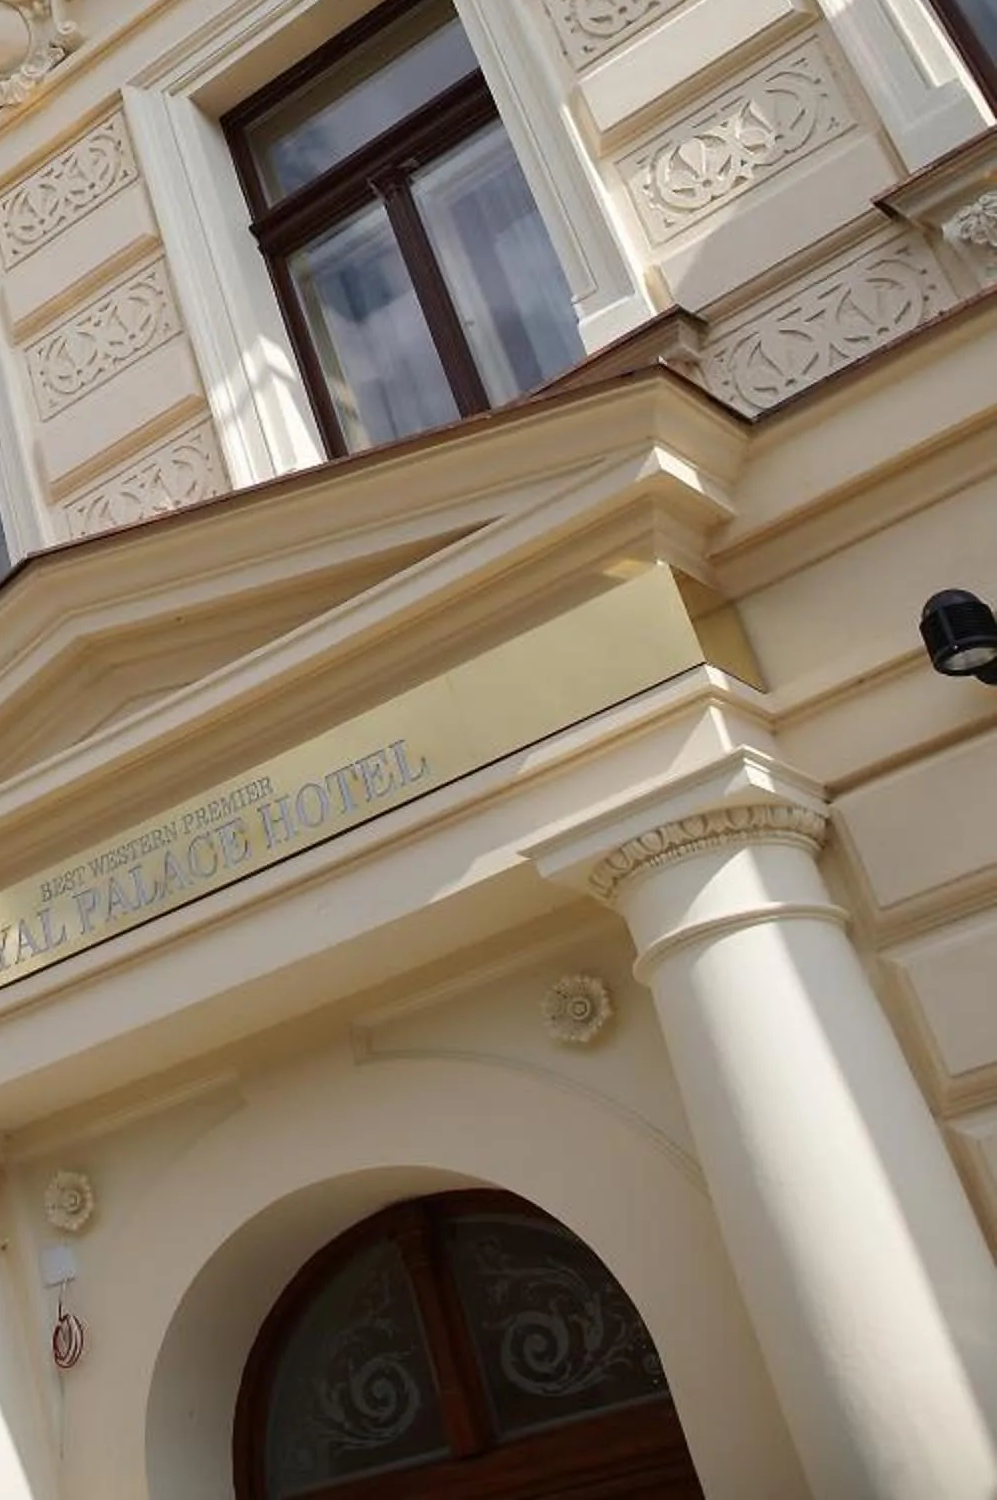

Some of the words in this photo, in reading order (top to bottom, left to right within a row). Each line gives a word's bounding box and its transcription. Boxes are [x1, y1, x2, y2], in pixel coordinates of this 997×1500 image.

[40, 864, 86, 903] BEST
[87, 821, 179, 879] WESTERN
[180, 775, 274, 835] PREMIER
[72, 816, 252, 936] PALACE
[257, 739, 431, 850] HOTEL
